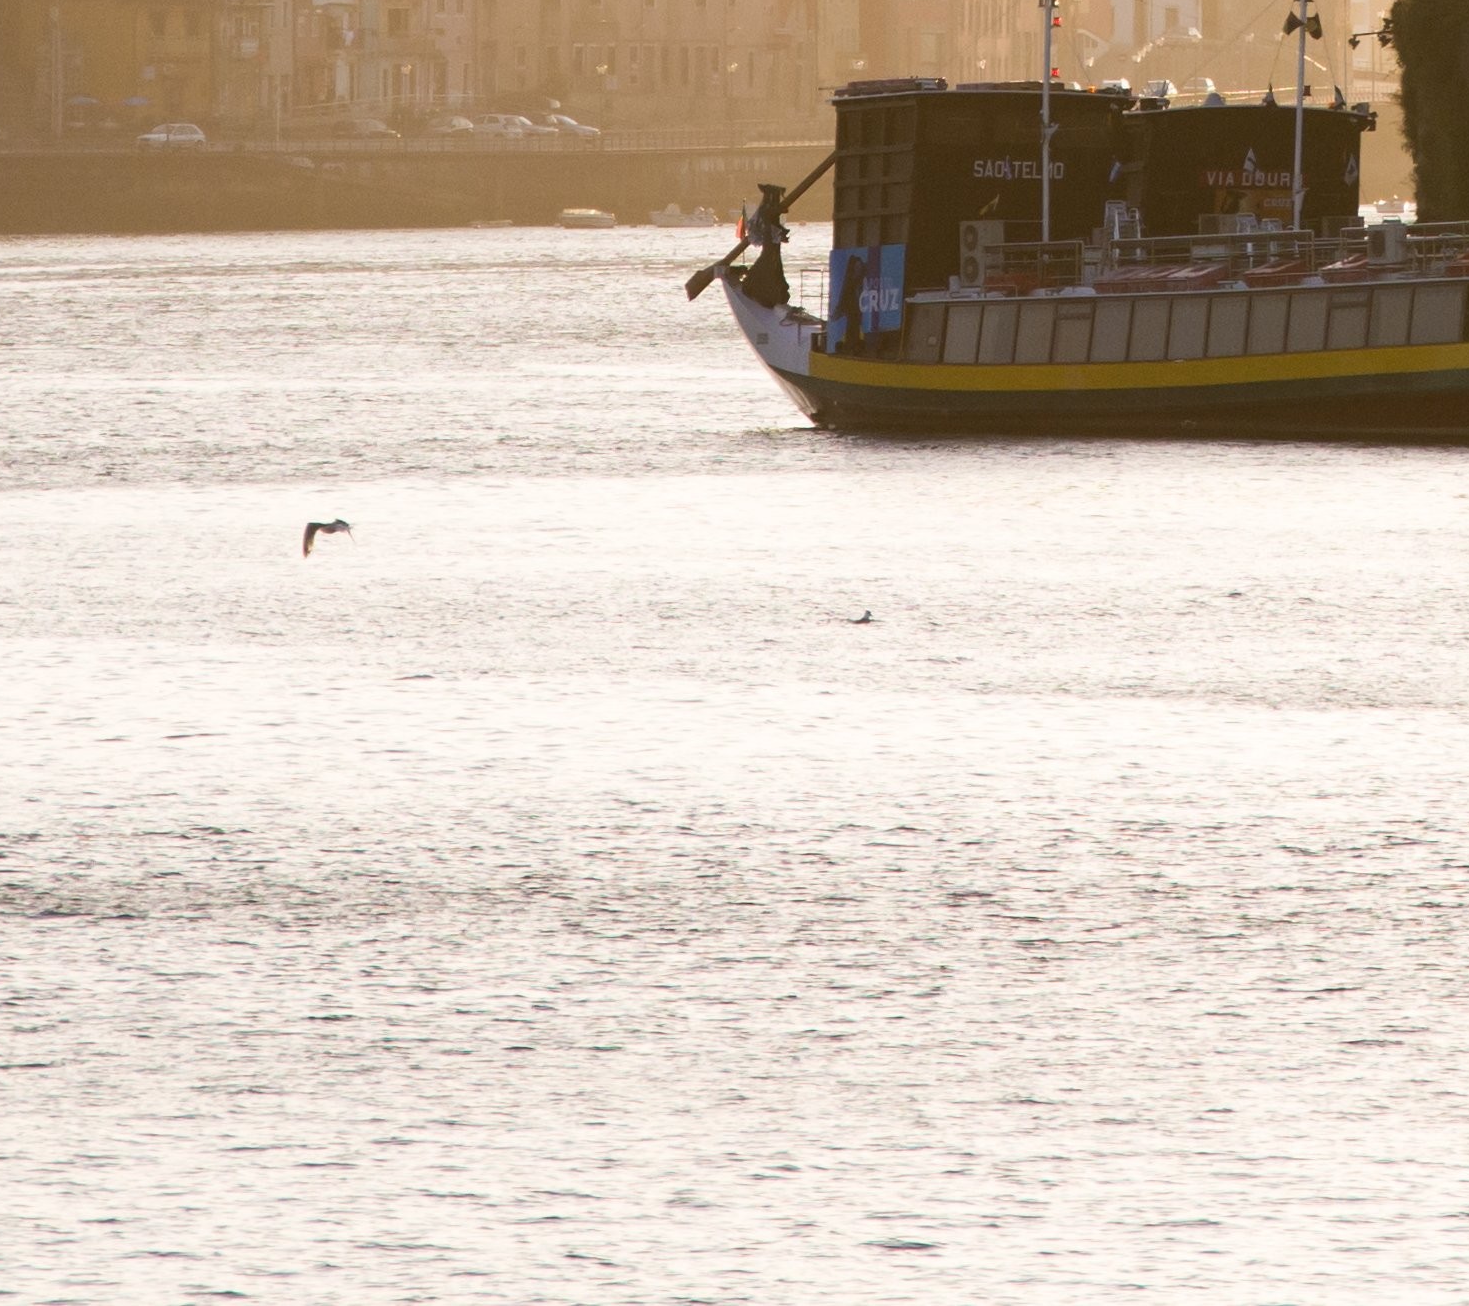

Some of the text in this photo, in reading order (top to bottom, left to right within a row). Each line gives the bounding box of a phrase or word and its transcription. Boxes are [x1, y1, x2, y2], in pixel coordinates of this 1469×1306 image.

[1207, 171, 1301, 187] VIA DOUR
[859, 288, 899, 313] CRUZ
